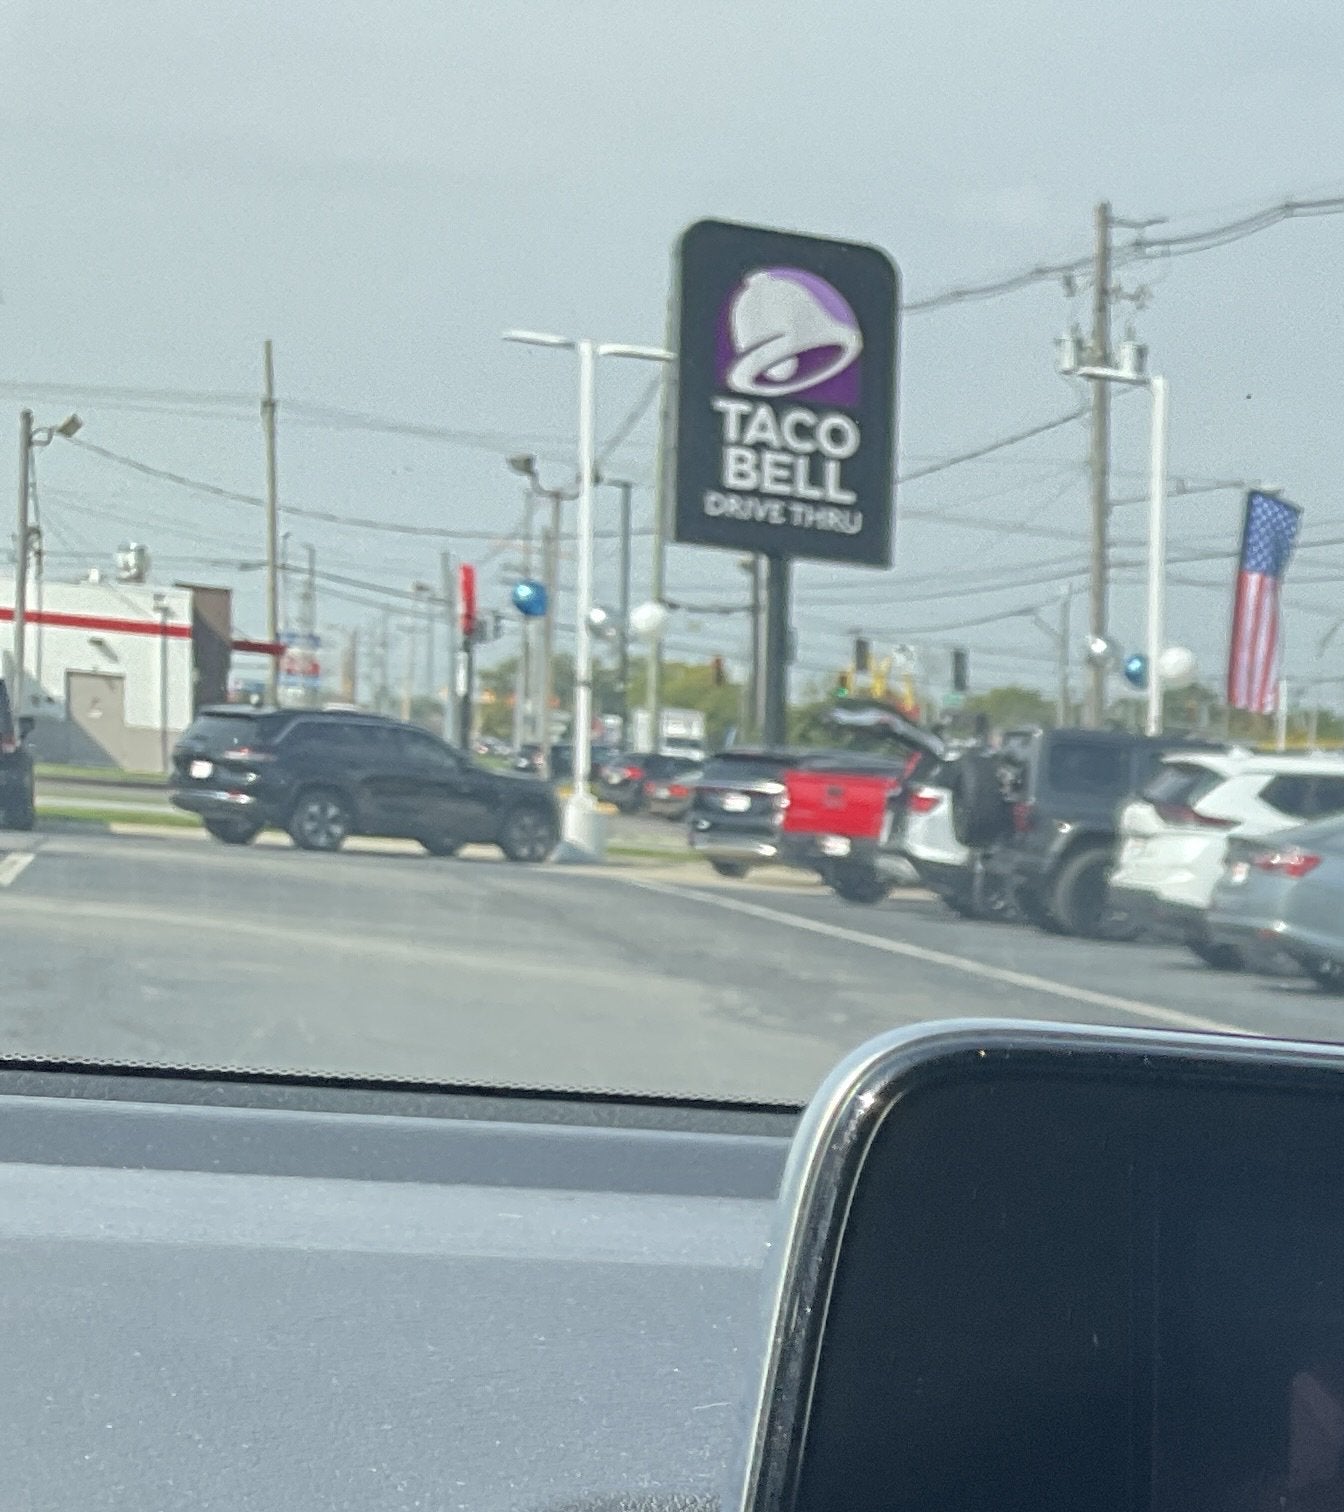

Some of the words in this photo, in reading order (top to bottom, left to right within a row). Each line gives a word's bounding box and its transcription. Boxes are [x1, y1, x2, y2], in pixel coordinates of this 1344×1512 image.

[712, 395, 861, 460] TACO
[723, 446, 858, 505] BELL
[704, 491, 787, 524] DRIVE
[788, 501, 864, 534] THRU
